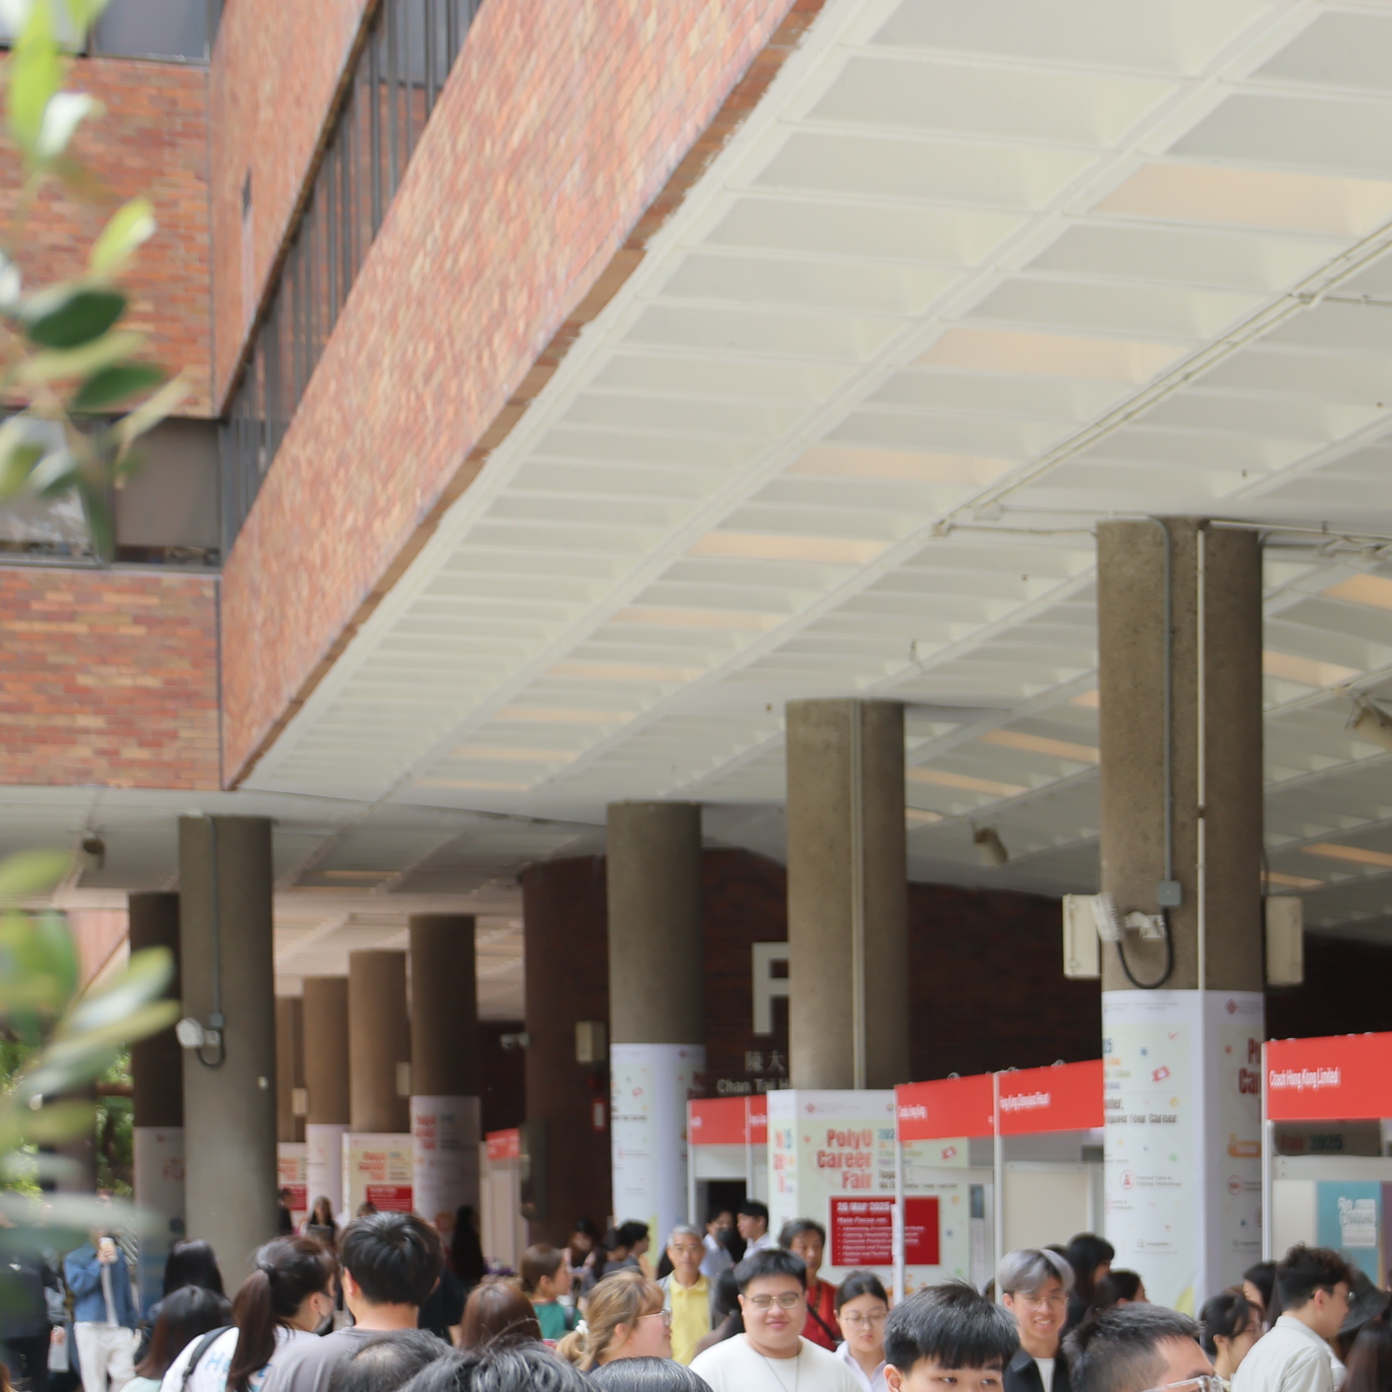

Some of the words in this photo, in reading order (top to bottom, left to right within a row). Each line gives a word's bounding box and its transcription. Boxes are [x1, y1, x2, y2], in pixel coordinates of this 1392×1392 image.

[827, 1129, 873, 1149] PolyU
[817, 1150, 873, 1168] Career
[842, 1169, 873, 1190] Fair
